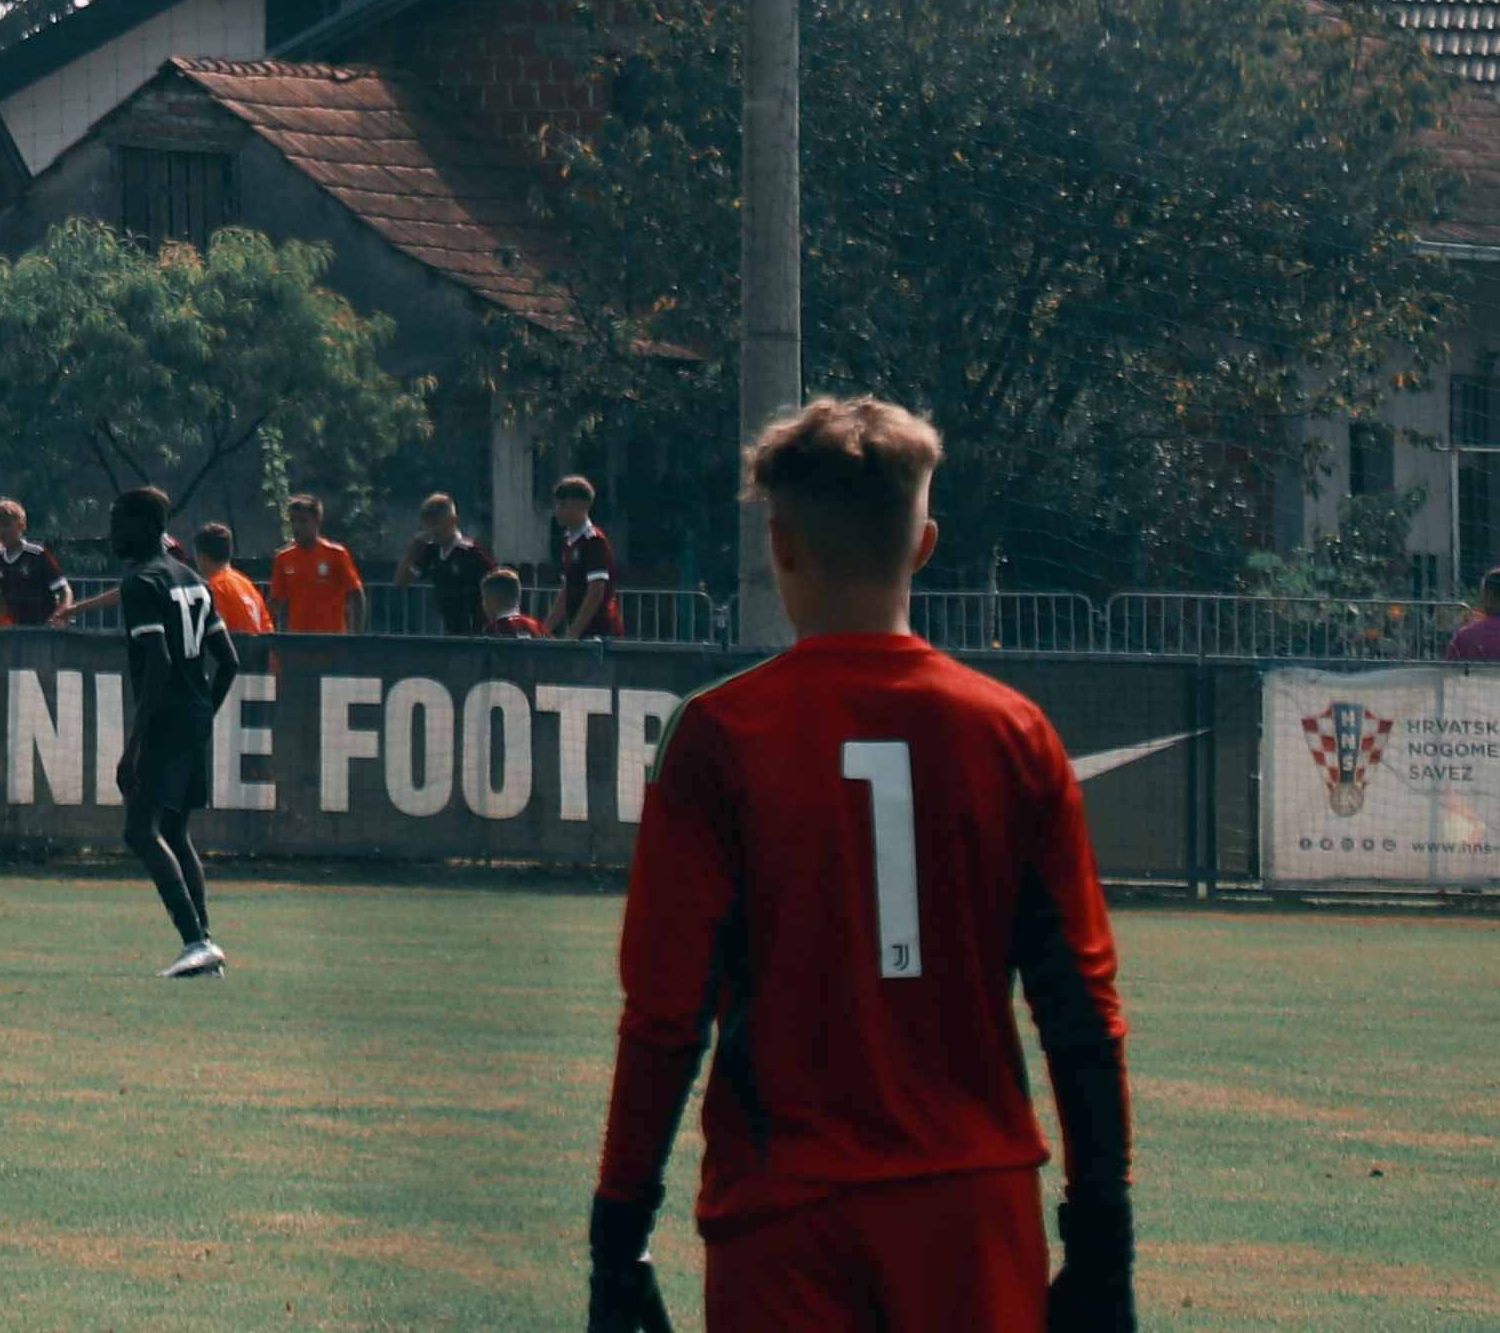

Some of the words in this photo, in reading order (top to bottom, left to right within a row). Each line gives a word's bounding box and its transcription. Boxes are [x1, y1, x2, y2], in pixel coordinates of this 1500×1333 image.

[170, 584, 211, 660] 17
[6, 669, 277, 811] NIE
[1340, 709, 1357, 772] HNS
[1406, 720, 1500, 736] HRVATSK
[1407, 742, 1500, 758] NOGOME
[1408, 764, 1474, 781] SAVEZ
[842, 741, 923, 979] 1
